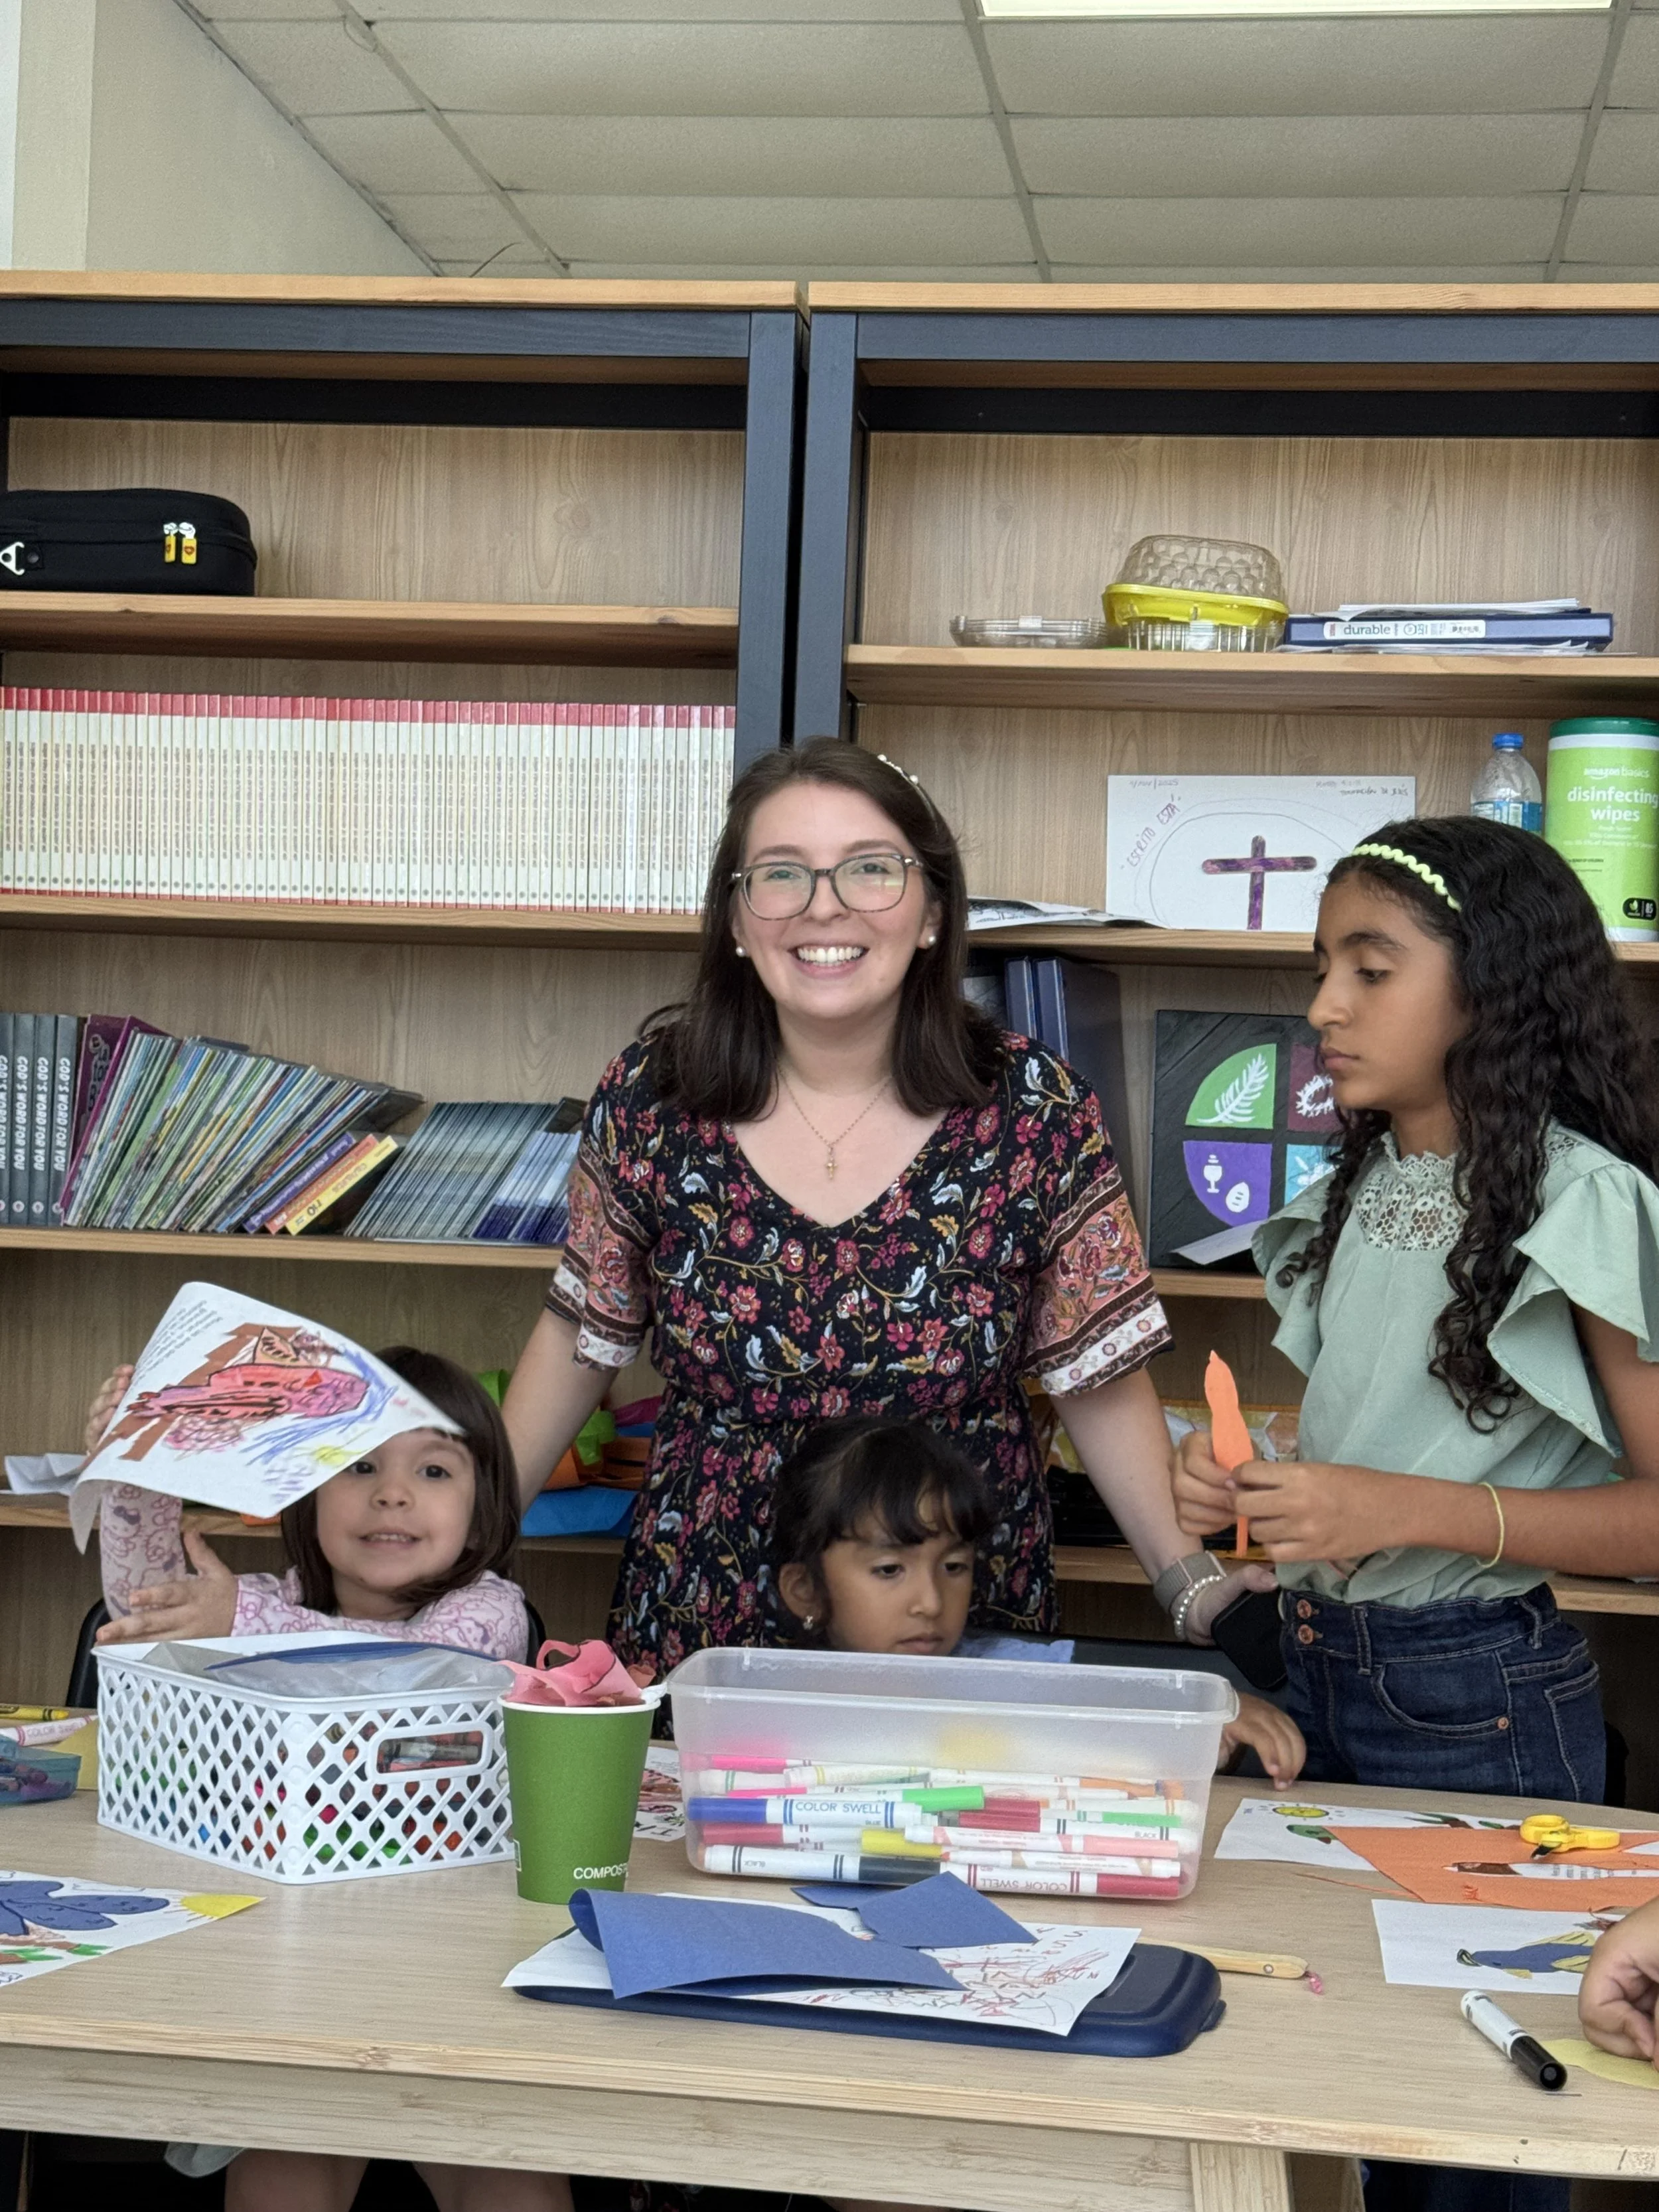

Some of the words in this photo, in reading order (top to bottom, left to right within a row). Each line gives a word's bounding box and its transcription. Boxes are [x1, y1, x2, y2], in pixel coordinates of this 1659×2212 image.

[1343, 625, 1391, 635] durable
[1567, 785, 1659, 809] disinfecting
[1590, 805, 1641, 825] wipes
[16, 1056, 29, 1091] GOD'S
[36, 1057, 49, 1092] GOD'S
[58, 1057, 71, 1092] GOD'S
[15, 1092, 27, 1124] WORD
[36, 1094, 47, 1124] WORD
[56, 1094, 68, 1126] WORD
[15, 1124, 26, 1146] FOR
[35, 1126, 46, 1147] FOR
[55, 1126, 68, 1148] FOR
[13, 1148, 25, 1170] YOU
[33, 1149, 45, 1171] YOU
[53, 1149, 66, 1172] YOU
[795, 1801, 837, 1812] COLOR
[842, 1803, 882, 1814] SWELL
[980, 1878, 1019, 1888] SWELL
[1025, 1881, 1068, 1891] COLOR
